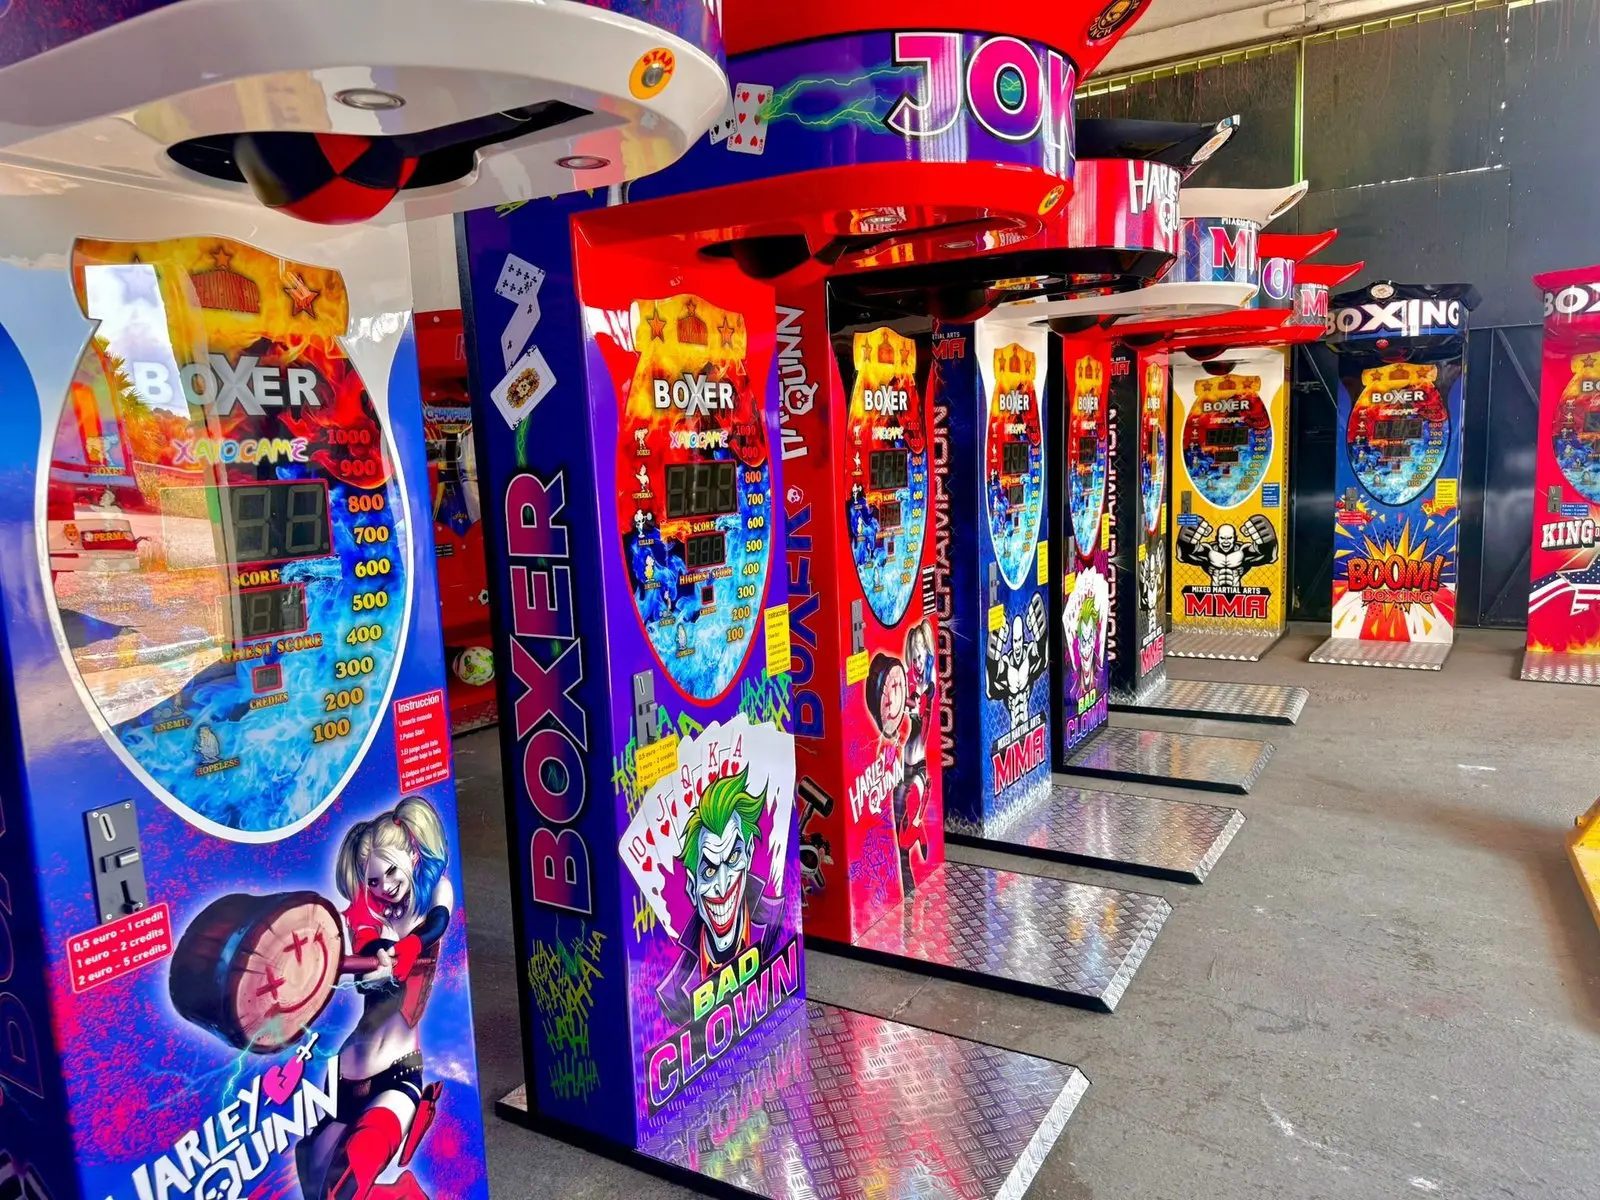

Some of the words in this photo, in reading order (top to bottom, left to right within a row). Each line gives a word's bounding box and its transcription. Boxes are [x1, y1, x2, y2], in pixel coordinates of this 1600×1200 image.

[643, 51, 672, 75] START
[1326, 299, 1459, 335] BOXING
[932, 337, 966, 360] MA
[133, 353, 321, 415] BOXER
[653, 373, 735, 416] BOXER
[1372, 389, 1424, 404] BOXER
[864, 385, 907, 416] BOXER
[1000, 390, 1030, 415] BOXER
[1203, 399, 1250, 413] BOXER
[327, 428, 371, 444] 1000
[340, 460, 376, 477] 900
[745, 471, 761, 483] 800
[348, 494, 384, 513] 800
[747, 493, 763, 505] 700
[353, 526, 389, 543] 700
[693, 521, 714, 533] SCORE
[747, 516, 763, 529] 600
[1541, 519, 1595, 548] KING
[746, 540, 762, 552] 500
[355, 558, 391, 577] 600
[742, 563, 759, 576] 400
[1347, 554, 1446, 592] BOOM!
[353, 591, 388, 611] 500
[738, 585, 755, 599] 300
[1361, 590, 1434, 603] BOXING
[732, 606, 750, 620] 200
[1184, 593, 1269, 618] MMA
[346, 624, 382, 645] 400
[727, 627, 744, 643] 100
[222, 640, 273, 663] GHEST
[276, 633, 323, 653] SCORE
[335, 657, 374, 678] 300
[324, 687, 364, 711] 200
[505, 470, 593, 914] BOXER
[1078, 688, 1097, 716] BAD
[312, 718, 350, 743] 100
[1066, 692, 1108, 750] CLOWN
[708, 742, 719, 767] K
[733, 734, 743, 757] A
[992, 723, 1046, 796] MMA
[681, 764, 692, 790] Q
[849, 750, 888, 824] HARLEY
[868, 760, 905, 814] QUINN
[656, 793, 667, 822] J
[628, 835, 647, 864] 10
[73, 939, 90, 953] 0,5
[92, 929, 117, 945] euro
[135, 911, 164, 930] credit
[77, 959, 82, 969] 1
[84, 949, 110, 966] euro
[120, 939, 127, 951] 2
[130, 928, 165, 947] credits
[78, 976, 86, 987] 2
[88, 966, 113, 982] euro
[123, 957, 131, 967] 5
[132, 943, 168, 963] credits
[692, 946, 760, 1022] BAD
[648, 941, 799, 1106] CLOWN
[106, 1075, 263, 1200] ARLEY
